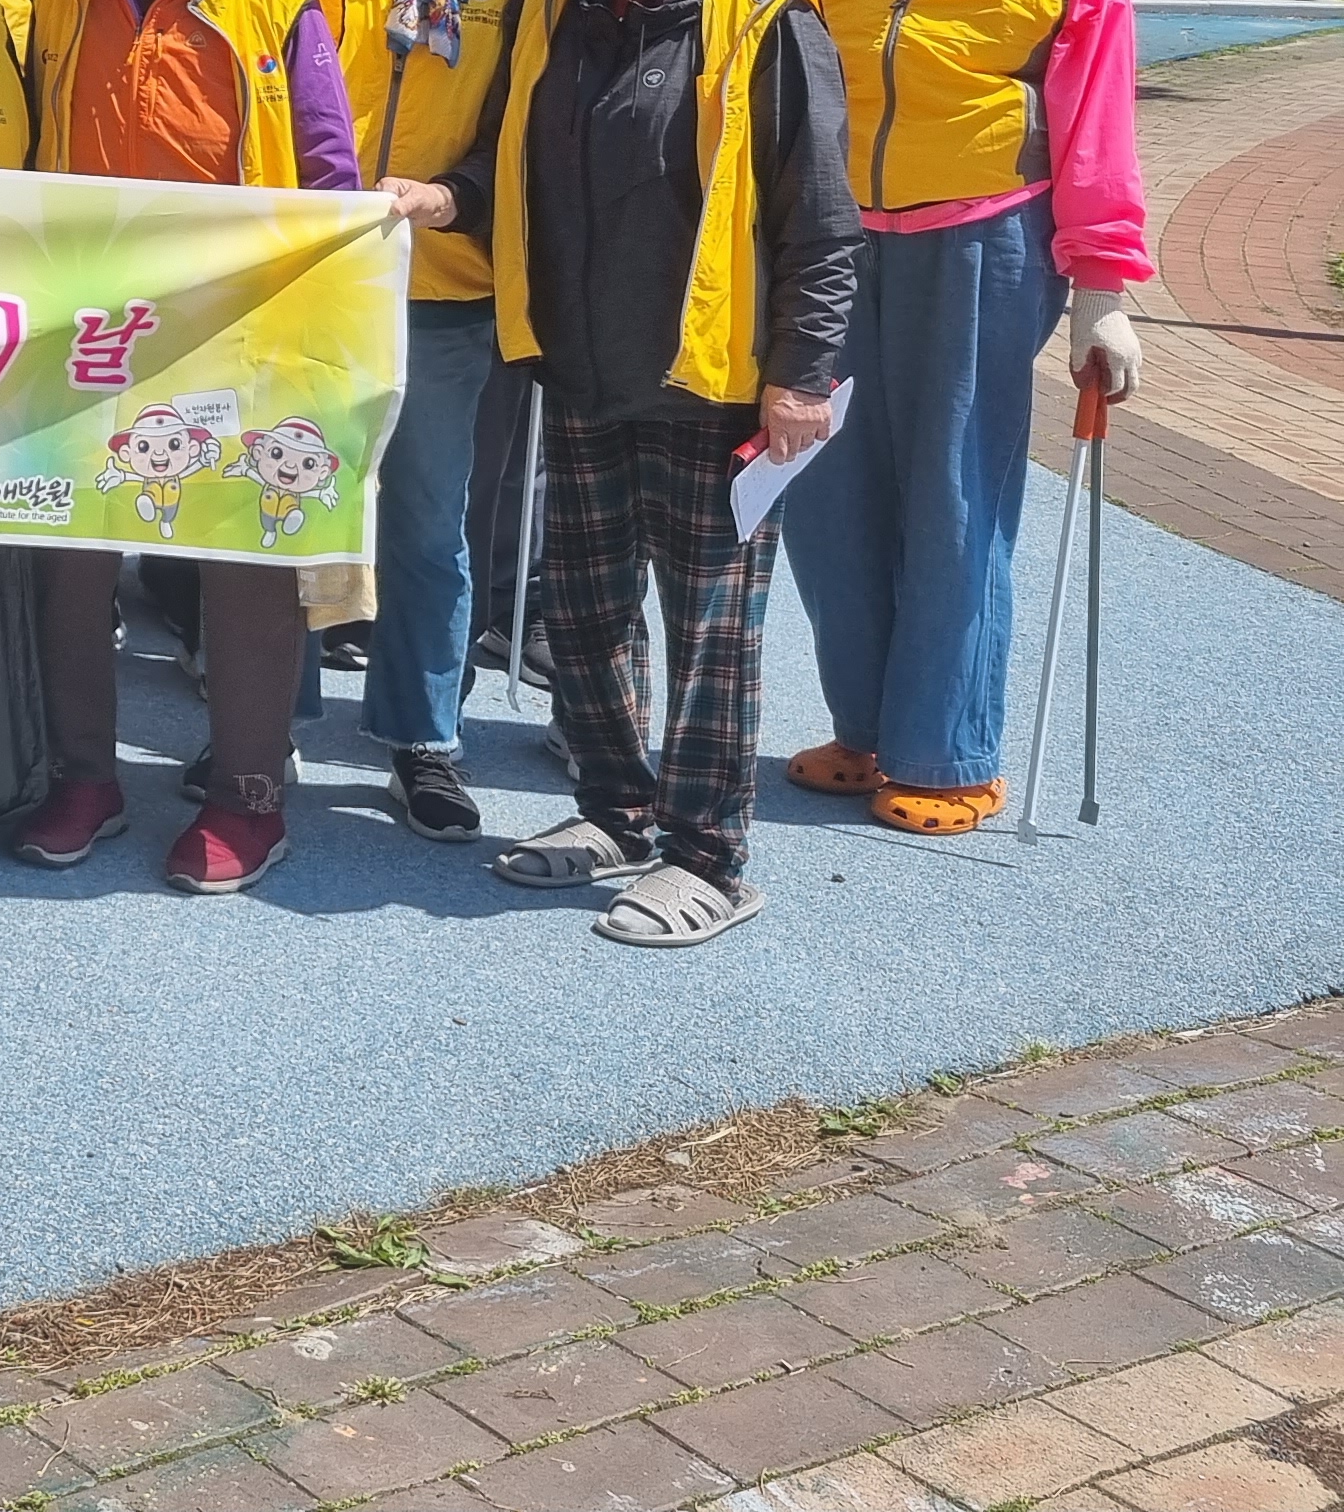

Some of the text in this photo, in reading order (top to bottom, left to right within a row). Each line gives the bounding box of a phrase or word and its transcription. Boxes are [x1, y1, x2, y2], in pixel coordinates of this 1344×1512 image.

[72, 304, 156, 386] 날
[18, 511, 29, 520] for
[31, 511, 46, 521] the
[46, 512, 68, 523] aged
